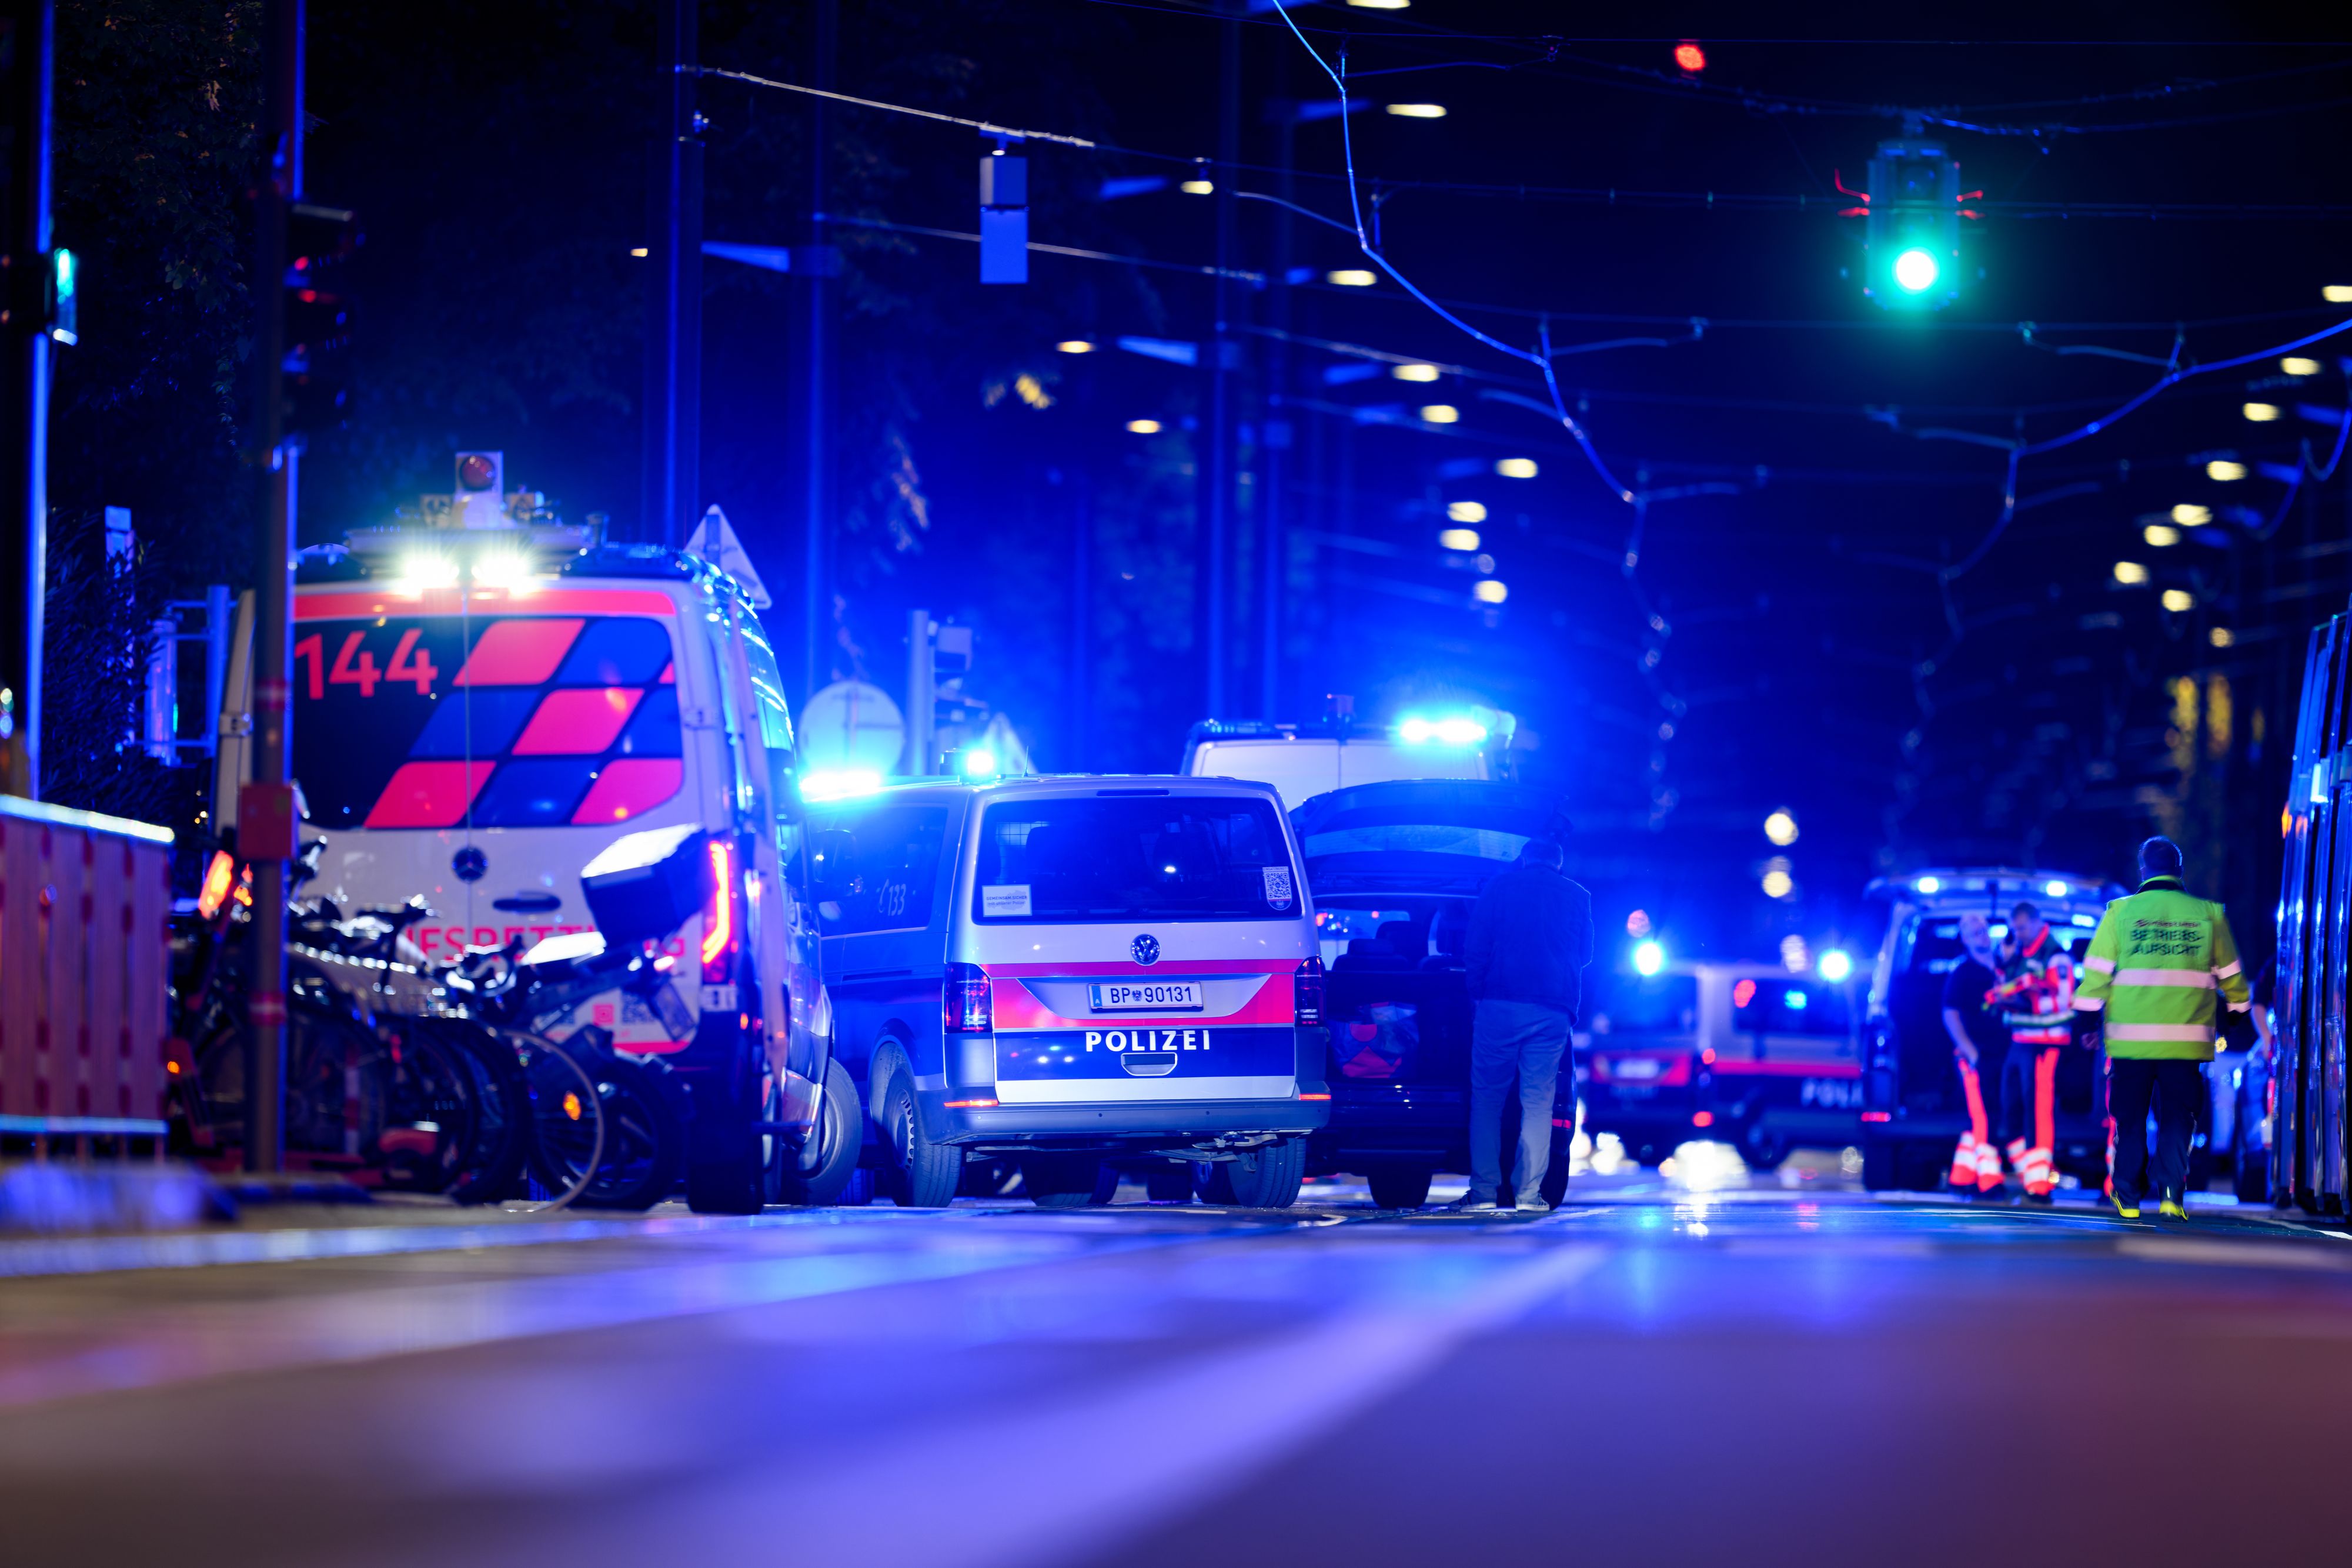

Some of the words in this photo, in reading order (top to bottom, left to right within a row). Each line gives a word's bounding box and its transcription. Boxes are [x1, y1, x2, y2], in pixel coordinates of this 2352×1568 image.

[295, 627, 438, 700] 144
[888, 883, 907, 916] 133
[2128, 942, 2201, 957] AUFSICHT
[1110, 987, 1130, 1004] BP
[1144, 987, 1192, 1003] 90131
[1085, 1030, 1210, 1052] POLIZEI
